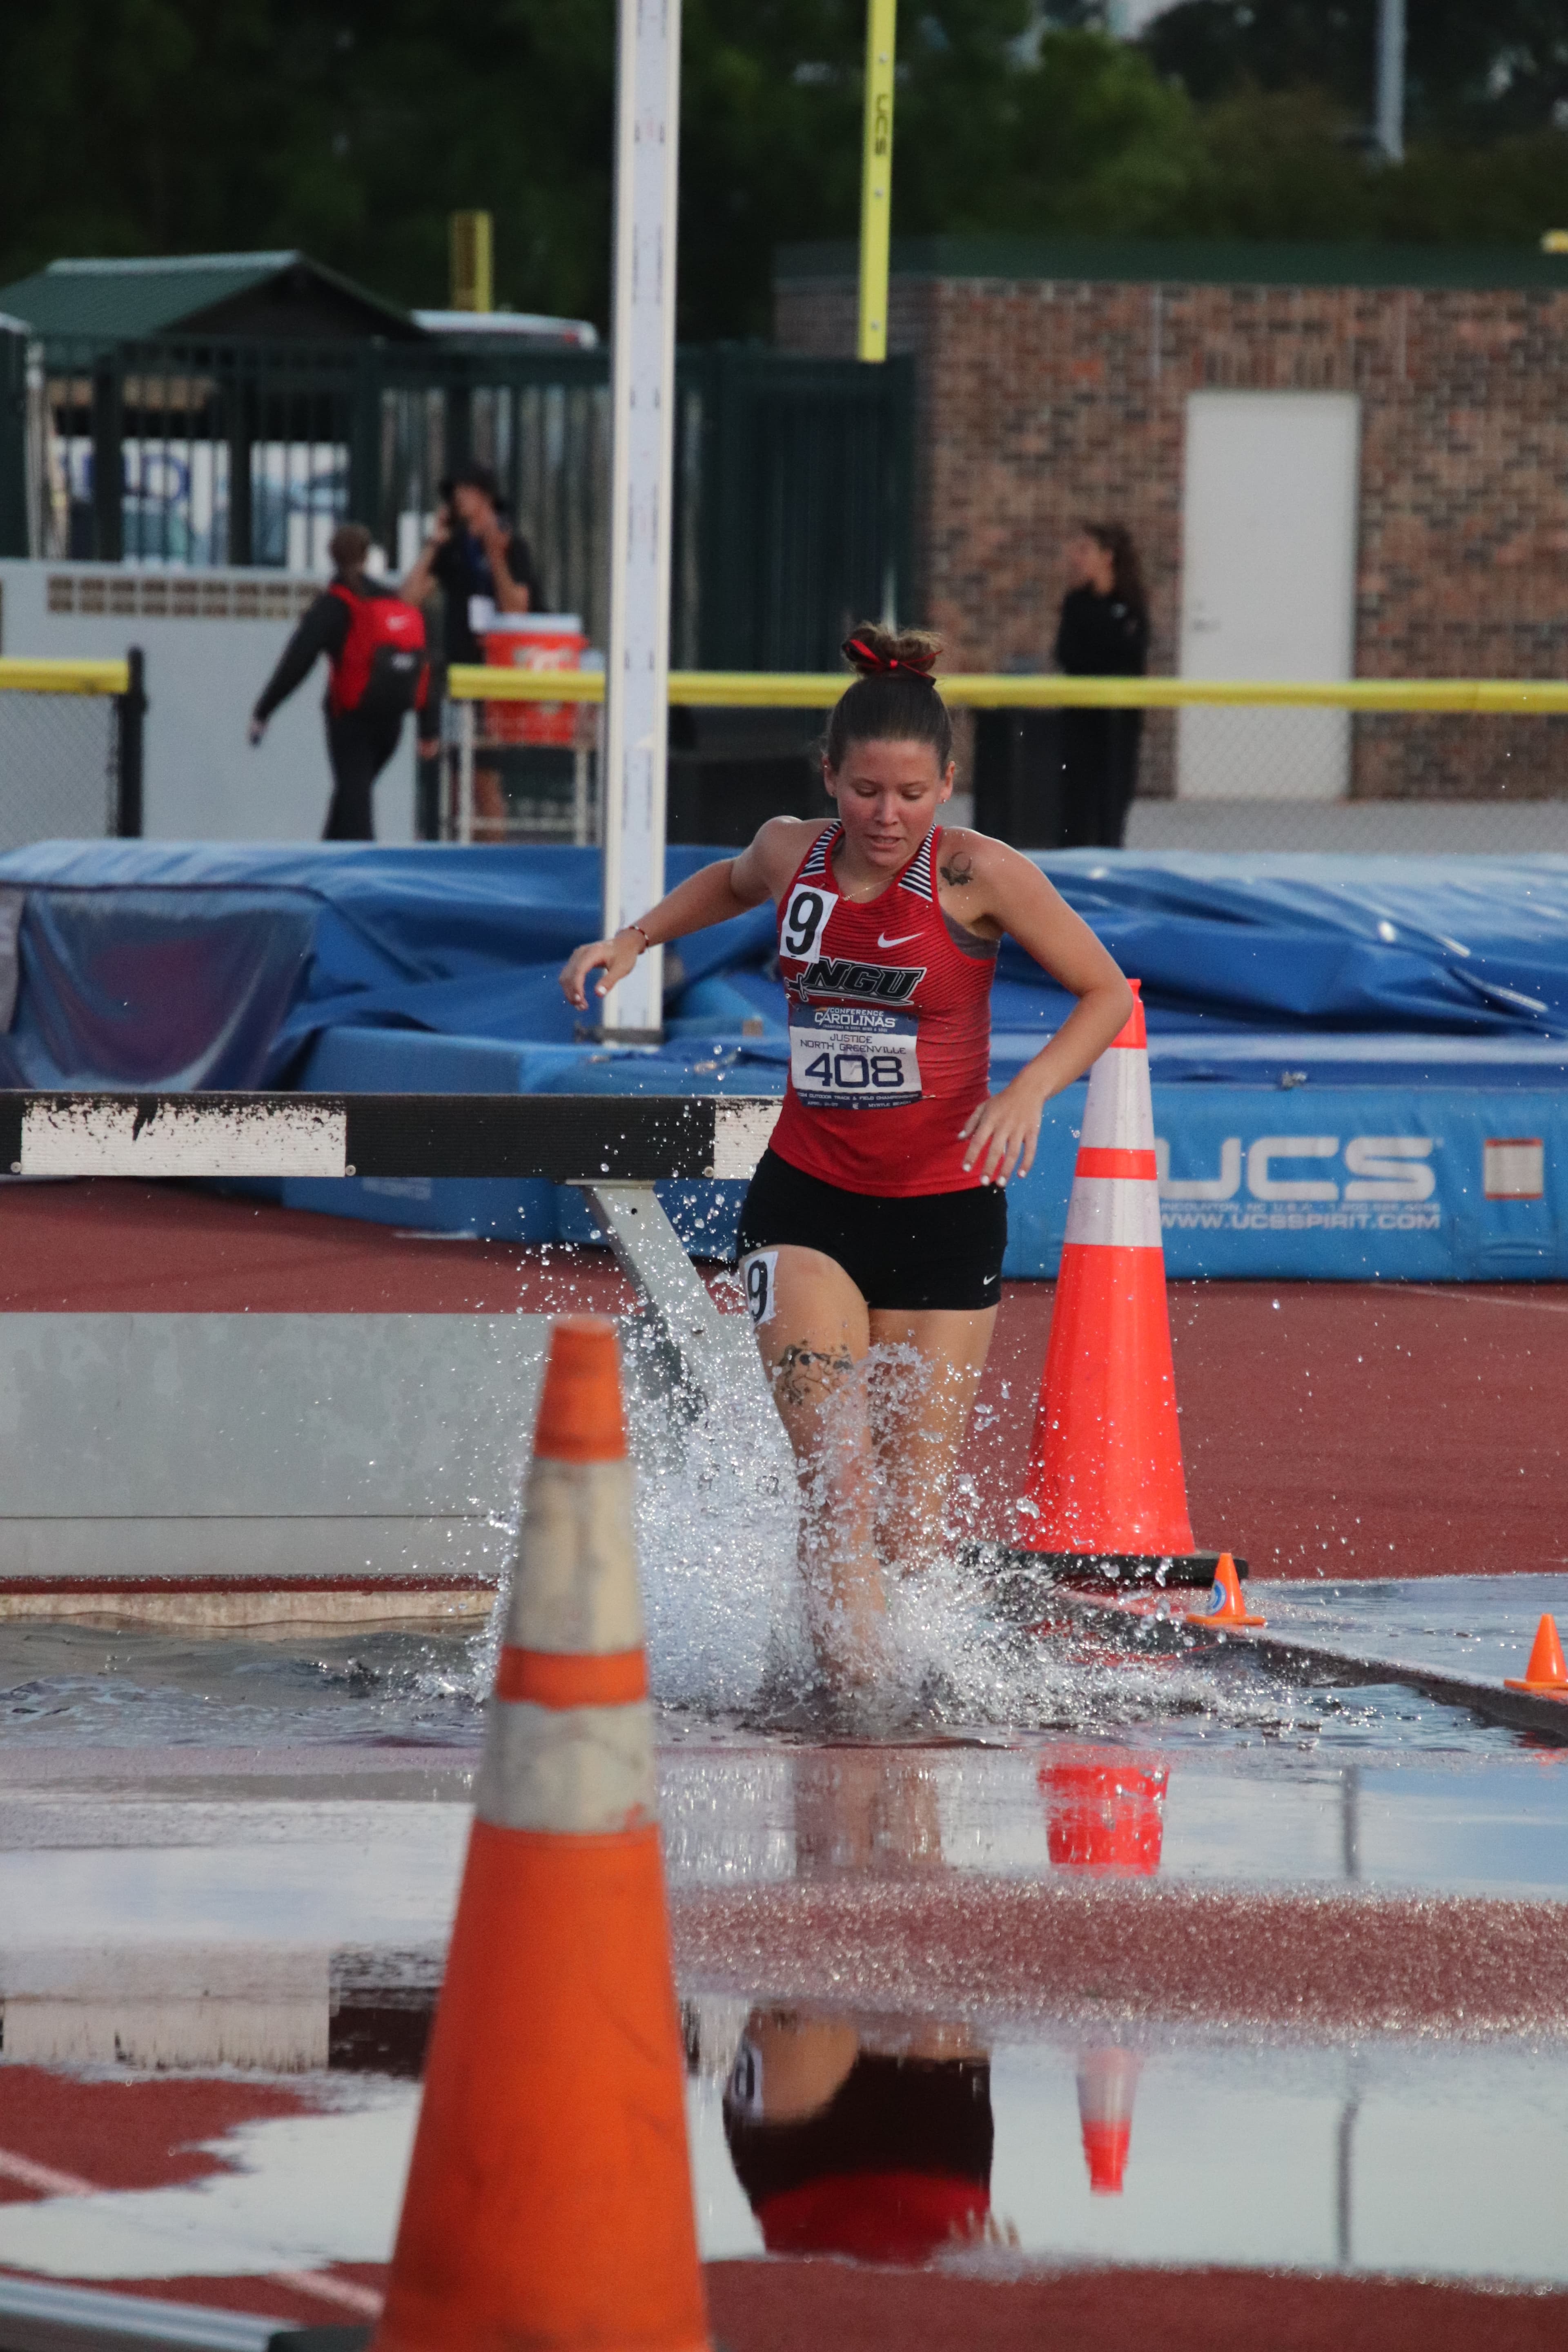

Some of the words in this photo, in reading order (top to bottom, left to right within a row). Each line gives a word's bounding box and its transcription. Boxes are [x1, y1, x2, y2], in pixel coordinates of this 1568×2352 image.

[875, 93, 889, 155] UCS
[786, 891, 824, 955] 9
[802, 955, 927, 1000] NGU
[814, 1010, 896, 1028] CAROLINAS
[830, 1007, 884, 1016] CONFERENCE
[800, 1039, 834, 1050] NORTH
[840, 1043, 906, 1054] GREENVILLE
[830, 1033, 873, 1044] JUSTICE
[805, 1053, 904, 1088] 408
[1154, 1137, 1436, 1200] UCS
[747, 1260, 768, 1323] 9
